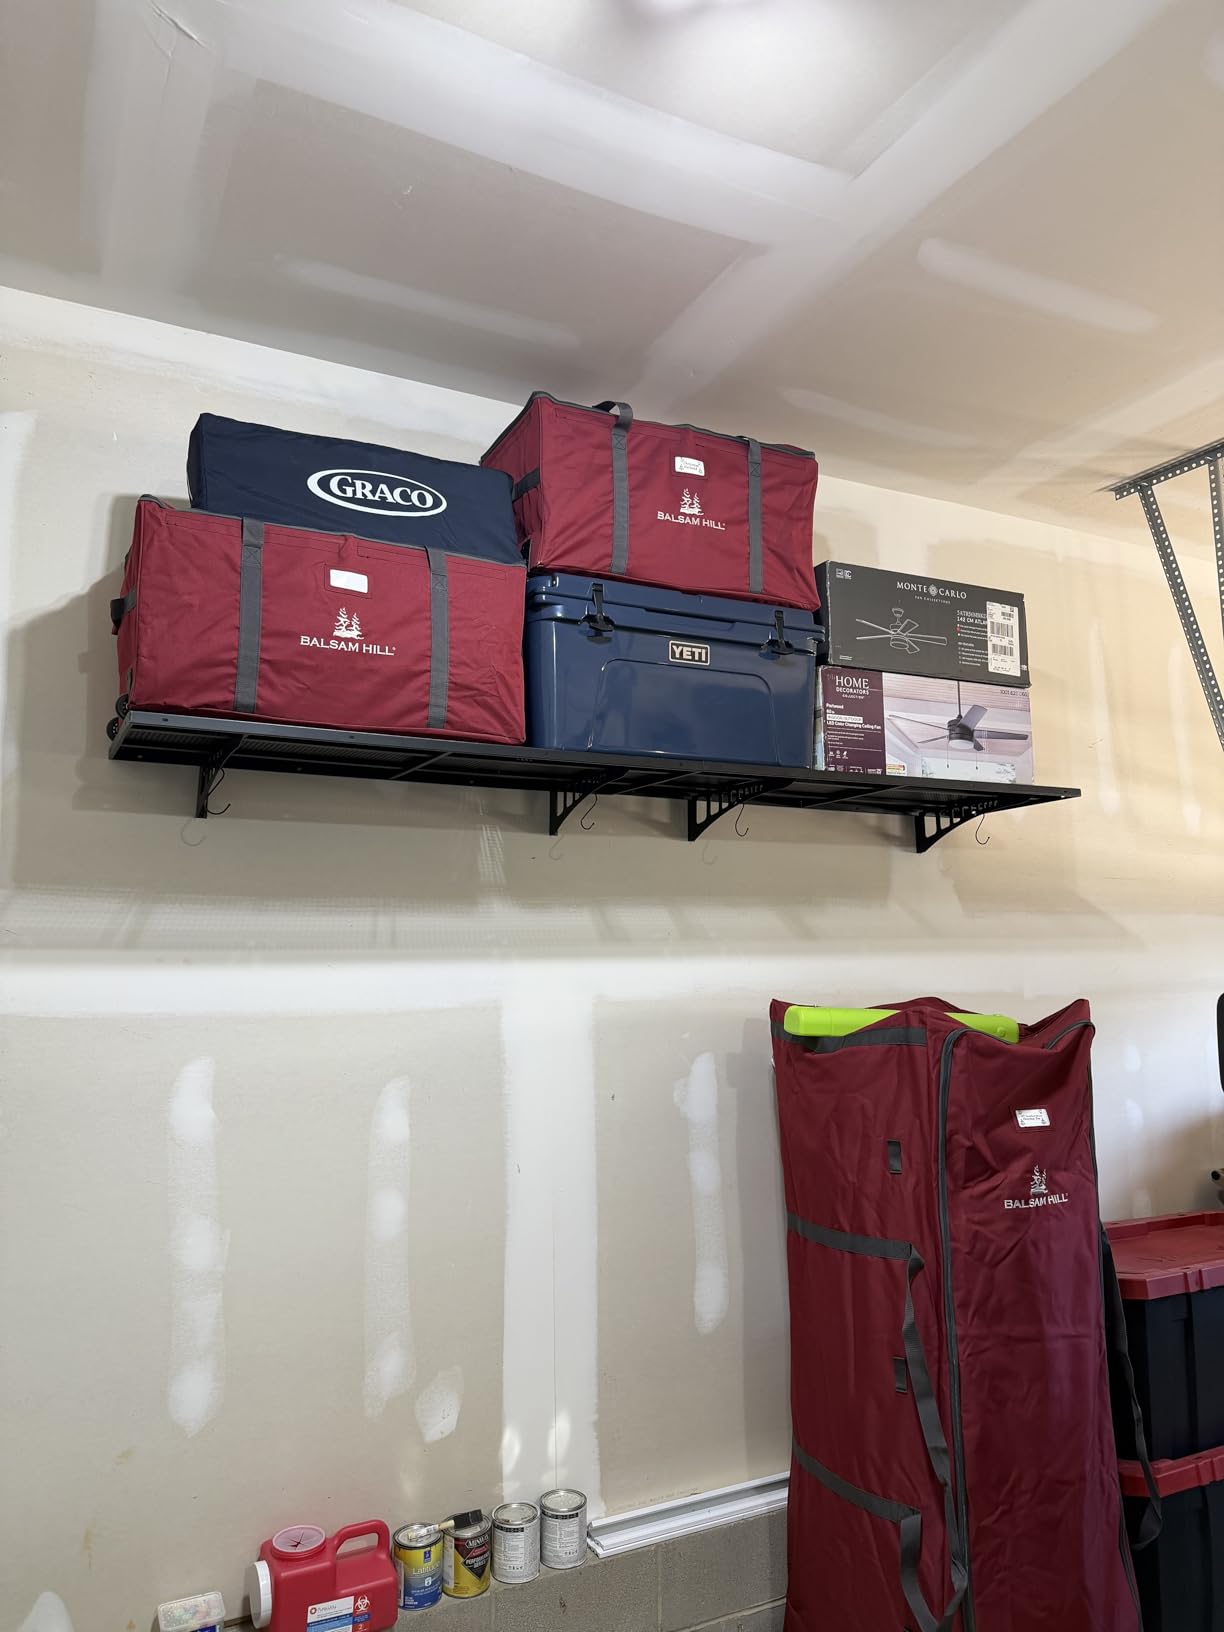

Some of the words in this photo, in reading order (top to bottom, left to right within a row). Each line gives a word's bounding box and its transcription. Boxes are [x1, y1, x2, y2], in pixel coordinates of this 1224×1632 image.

[329, 475, 433, 508] GRACO
[657, 511, 700, 526] BALSAM
[702, 519, 725, 530] HILL
[896, 582, 928, 592] MONTE
[938, 588, 966, 599] CARLO
[300, 636, 359, 652] BALSAM
[362, 644, 394, 656] HILL
[672, 645, 706, 661] YETI
[836, 676, 869, 689] HOME
[836, 687, 869, 696] DECORATORS
[1004, 1197, 1046, 1208] BALSAM
[1048, 1193, 1068, 1204] HILL
